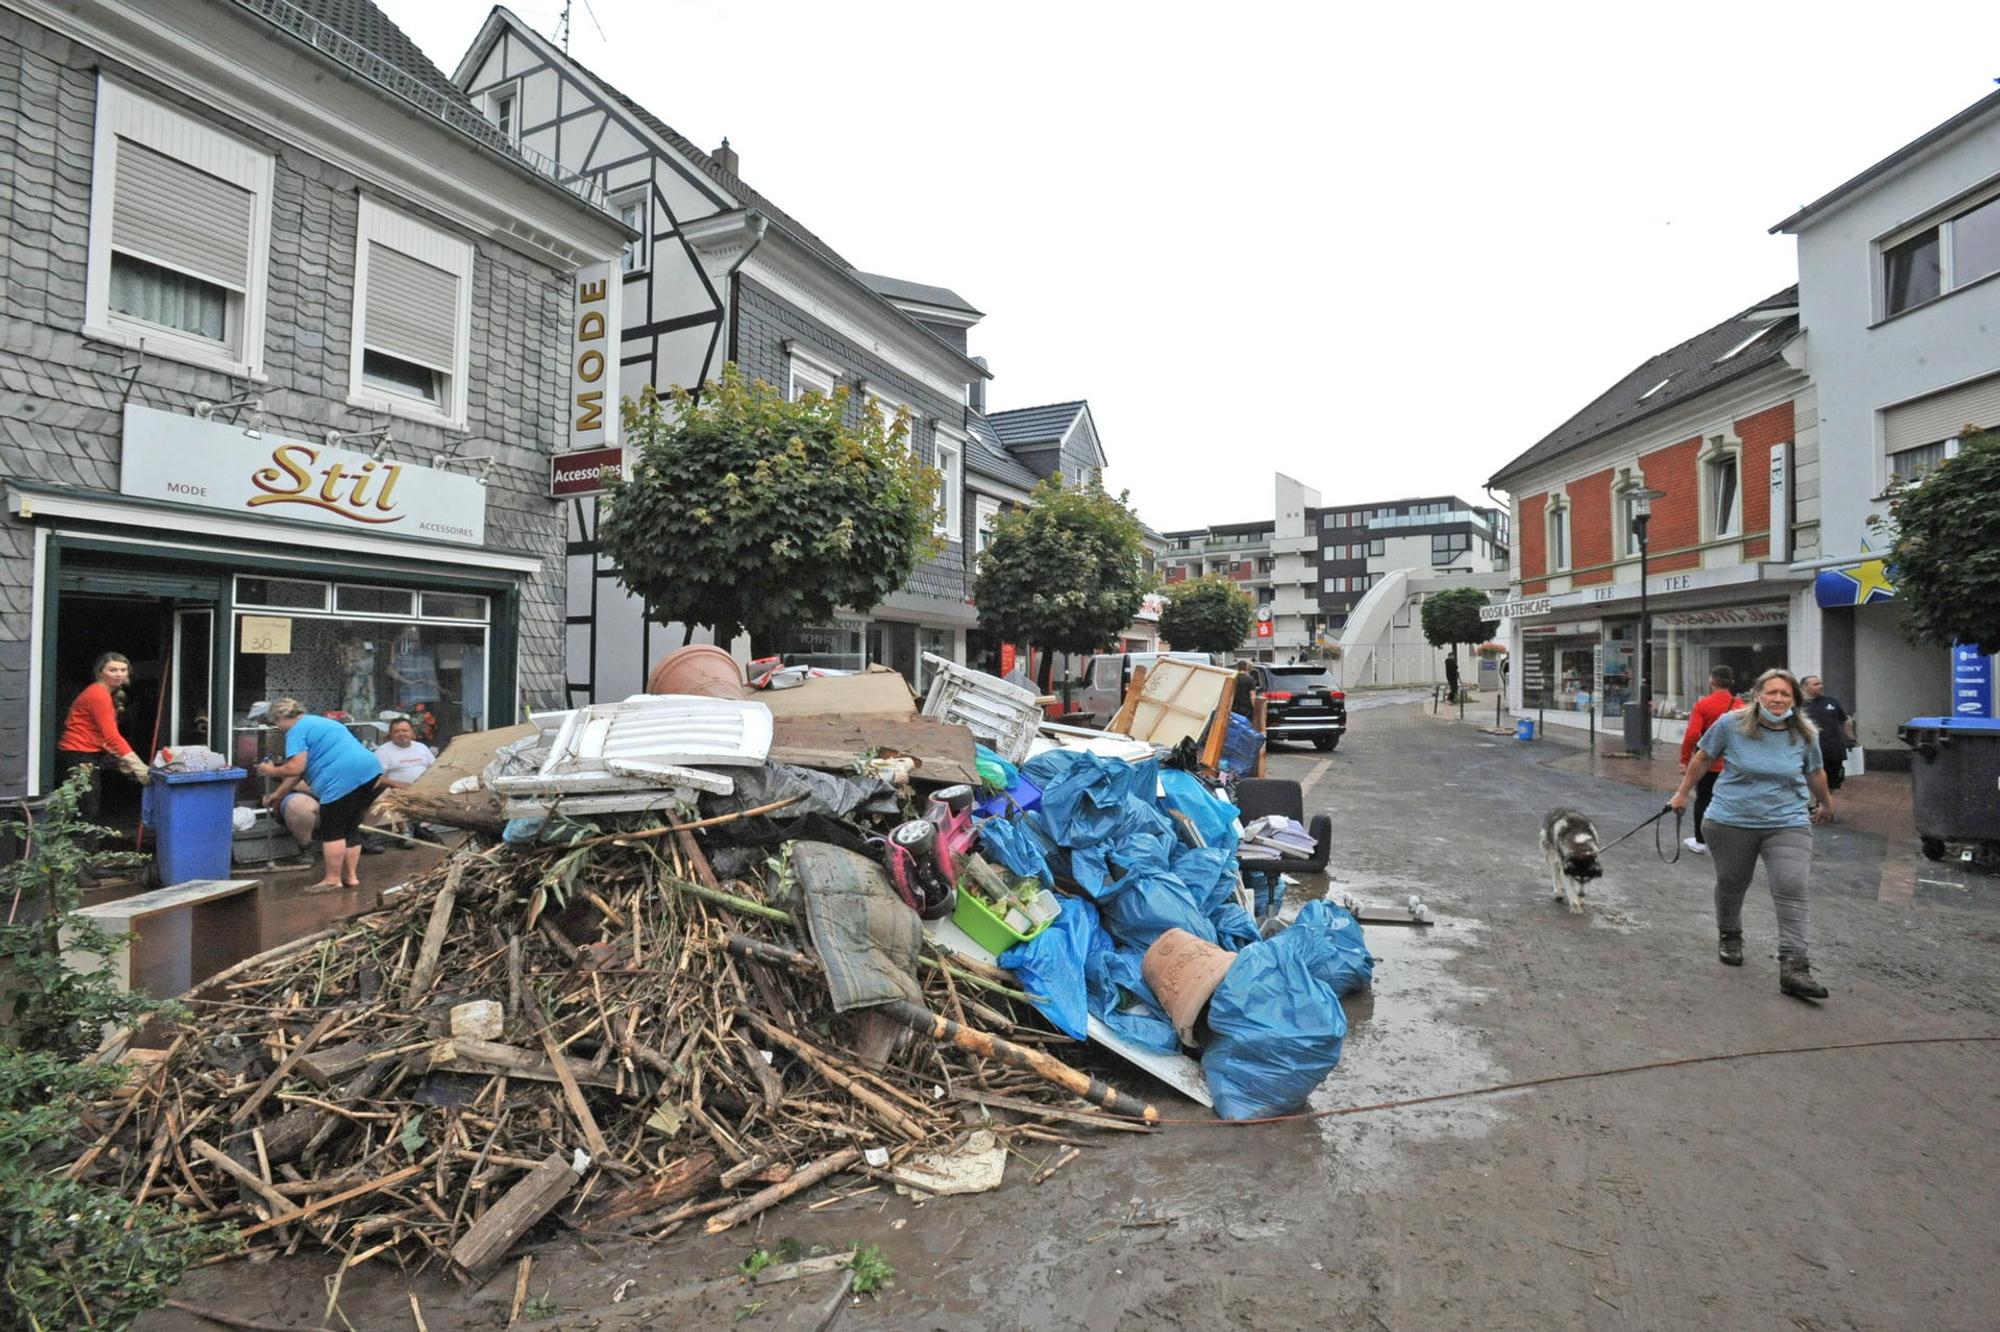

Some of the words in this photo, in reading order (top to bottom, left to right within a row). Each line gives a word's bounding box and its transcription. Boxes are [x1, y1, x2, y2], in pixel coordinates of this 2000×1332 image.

[576, 278, 607, 431] MODE
[250, 444, 405, 514] Stil
[1771, 451, 1783, 493] TEE
[167, 482, 207, 497] MODE
[418, 522, 474, 537] ACCESSOIRES
[1594, 586, 1615, 600] TEE
[1664, 575, 1691, 591] TEE
[1482, 607, 1503, 619] KIOSK
[1503, 605, 1510, 617] &
[1511, 600, 1550, 615] STEHCAFE
